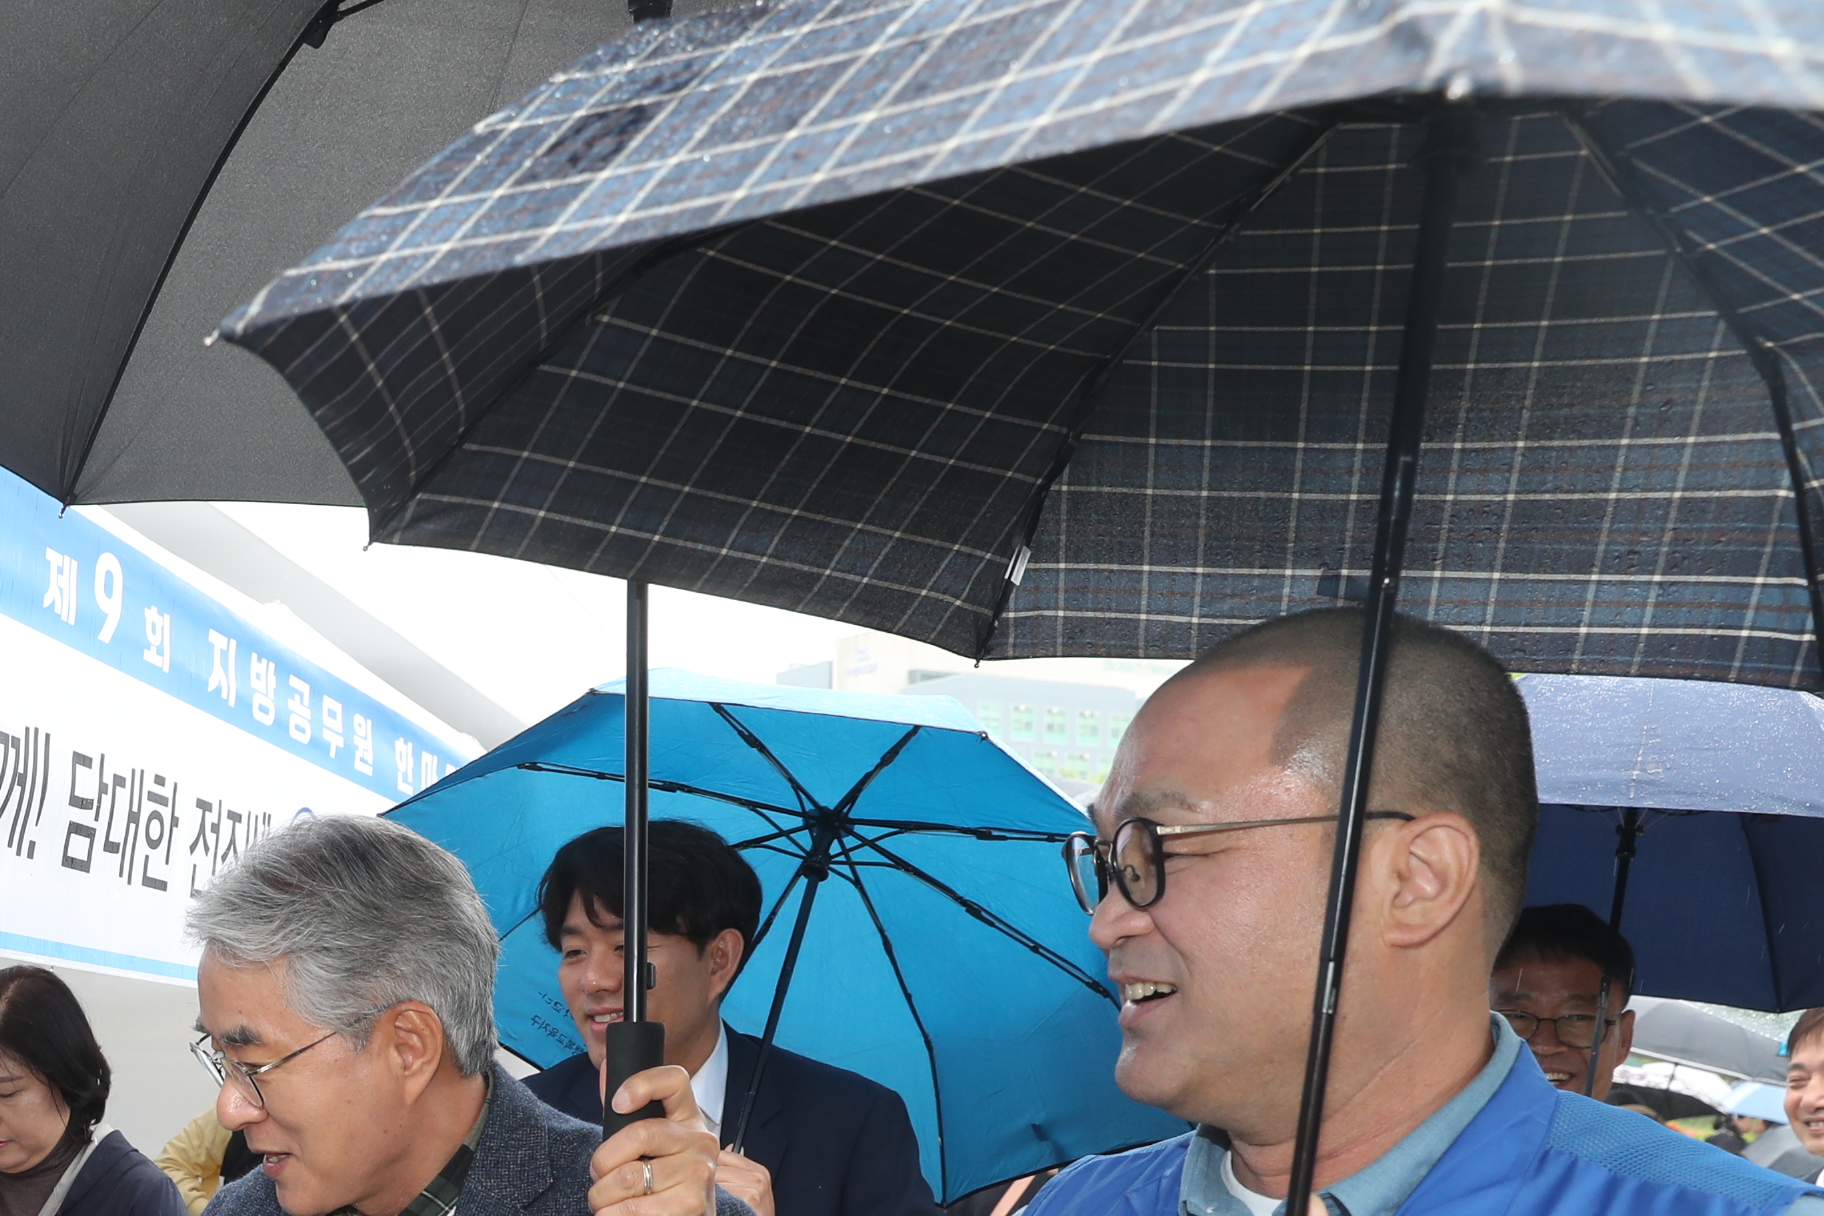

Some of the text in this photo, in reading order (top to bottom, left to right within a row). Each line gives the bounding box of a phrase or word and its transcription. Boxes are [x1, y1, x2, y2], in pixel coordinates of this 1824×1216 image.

[207, 628, 374, 777] 지방공무원
[394, 736, 460, 796] 한마
[61, 751, 179, 892] 담대한
